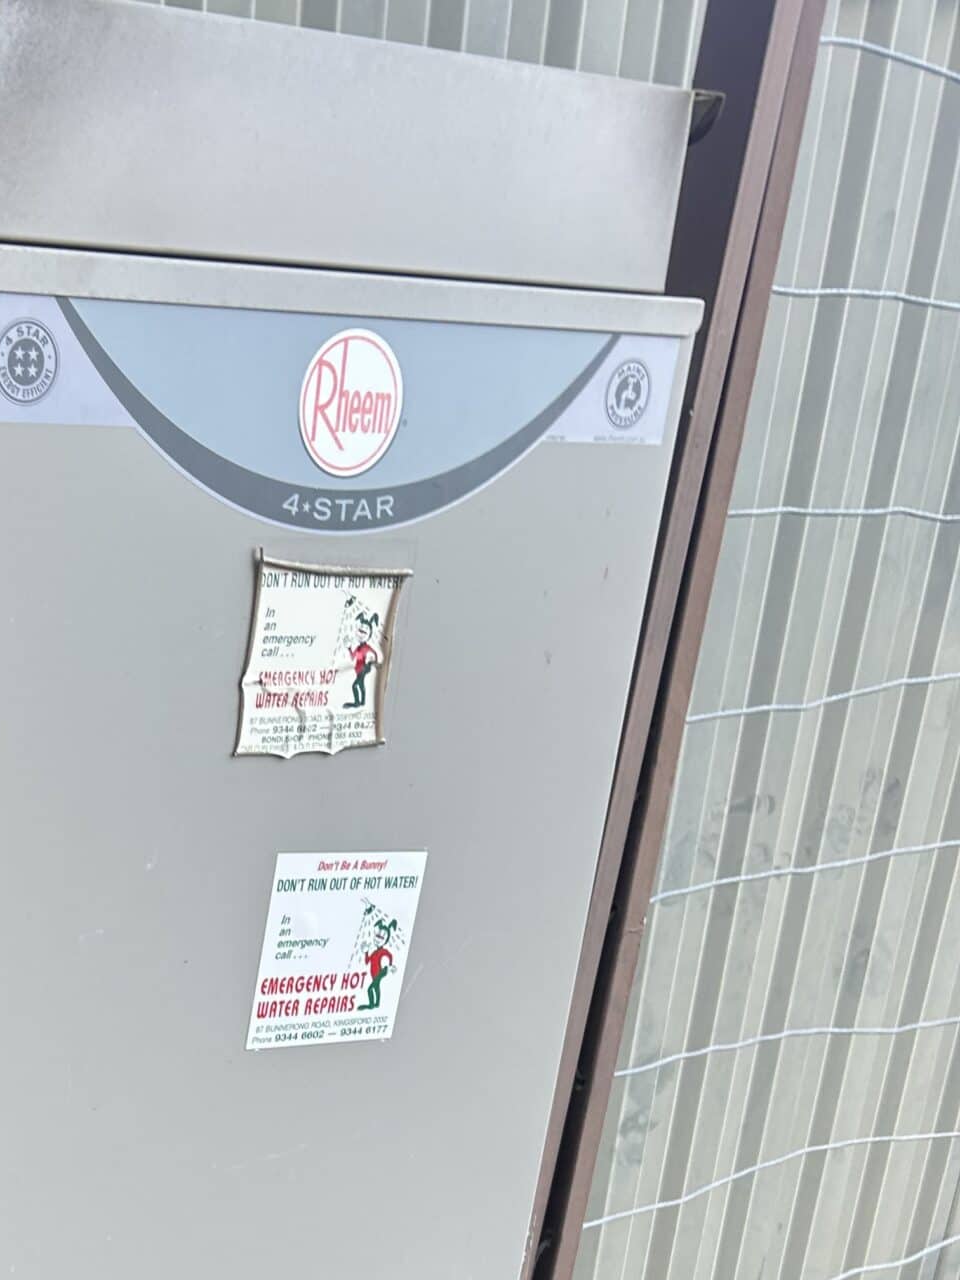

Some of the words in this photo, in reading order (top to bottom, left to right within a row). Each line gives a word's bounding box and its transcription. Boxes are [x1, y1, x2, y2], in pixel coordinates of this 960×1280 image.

[16, 325, 49, 347] STAR
[311, 337, 393, 451] Rheem
[313, 494, 395, 521] STAR
[261, 572, 289, 588] DON'T
[291, 572, 310, 588] RUN
[313, 574, 332, 588] OUT
[334, 575, 345, 588] OF
[348, 575, 366, 588] HOT
[265, 607, 276, 618] In
[263, 622, 277, 632] an
[262, 635, 316, 647] emergency
[258, 670, 316, 687] EMERGENCY
[319, 669, 339, 685] HOT
[255, 692, 289, 708] WATER
[290, 690, 329, 707] REPAIRS
[317, 860, 339, 872] Don't
[340, 860, 350, 871] Be
[352, 860, 359, 871] A
[360, 859, 388, 872] Bunny!
[277, 878, 306, 892] DON'T
[308, 878, 326, 891] RUN
[329, 877, 348, 891] OUT
[350, 877, 362, 890] OF
[364, 877, 382, 890] HOT
[384, 875, 419, 889] WATER!
[281, 914, 291, 925] In
[278, 927, 291, 937] an
[277, 937, 330, 949] emergency
[260, 974, 338, 996] EMERGENCY
[341, 972, 368, 990] HOT
[256, 1001, 299, 1019] WATER
[304, 995, 357, 1016] REPAIRS
[274, 1032, 298, 1042] 9344
[301, 1030, 325, 1040] 6602
[339, 1027, 363, 1036] 9344
[365, 1025, 389, 1034] 6177
